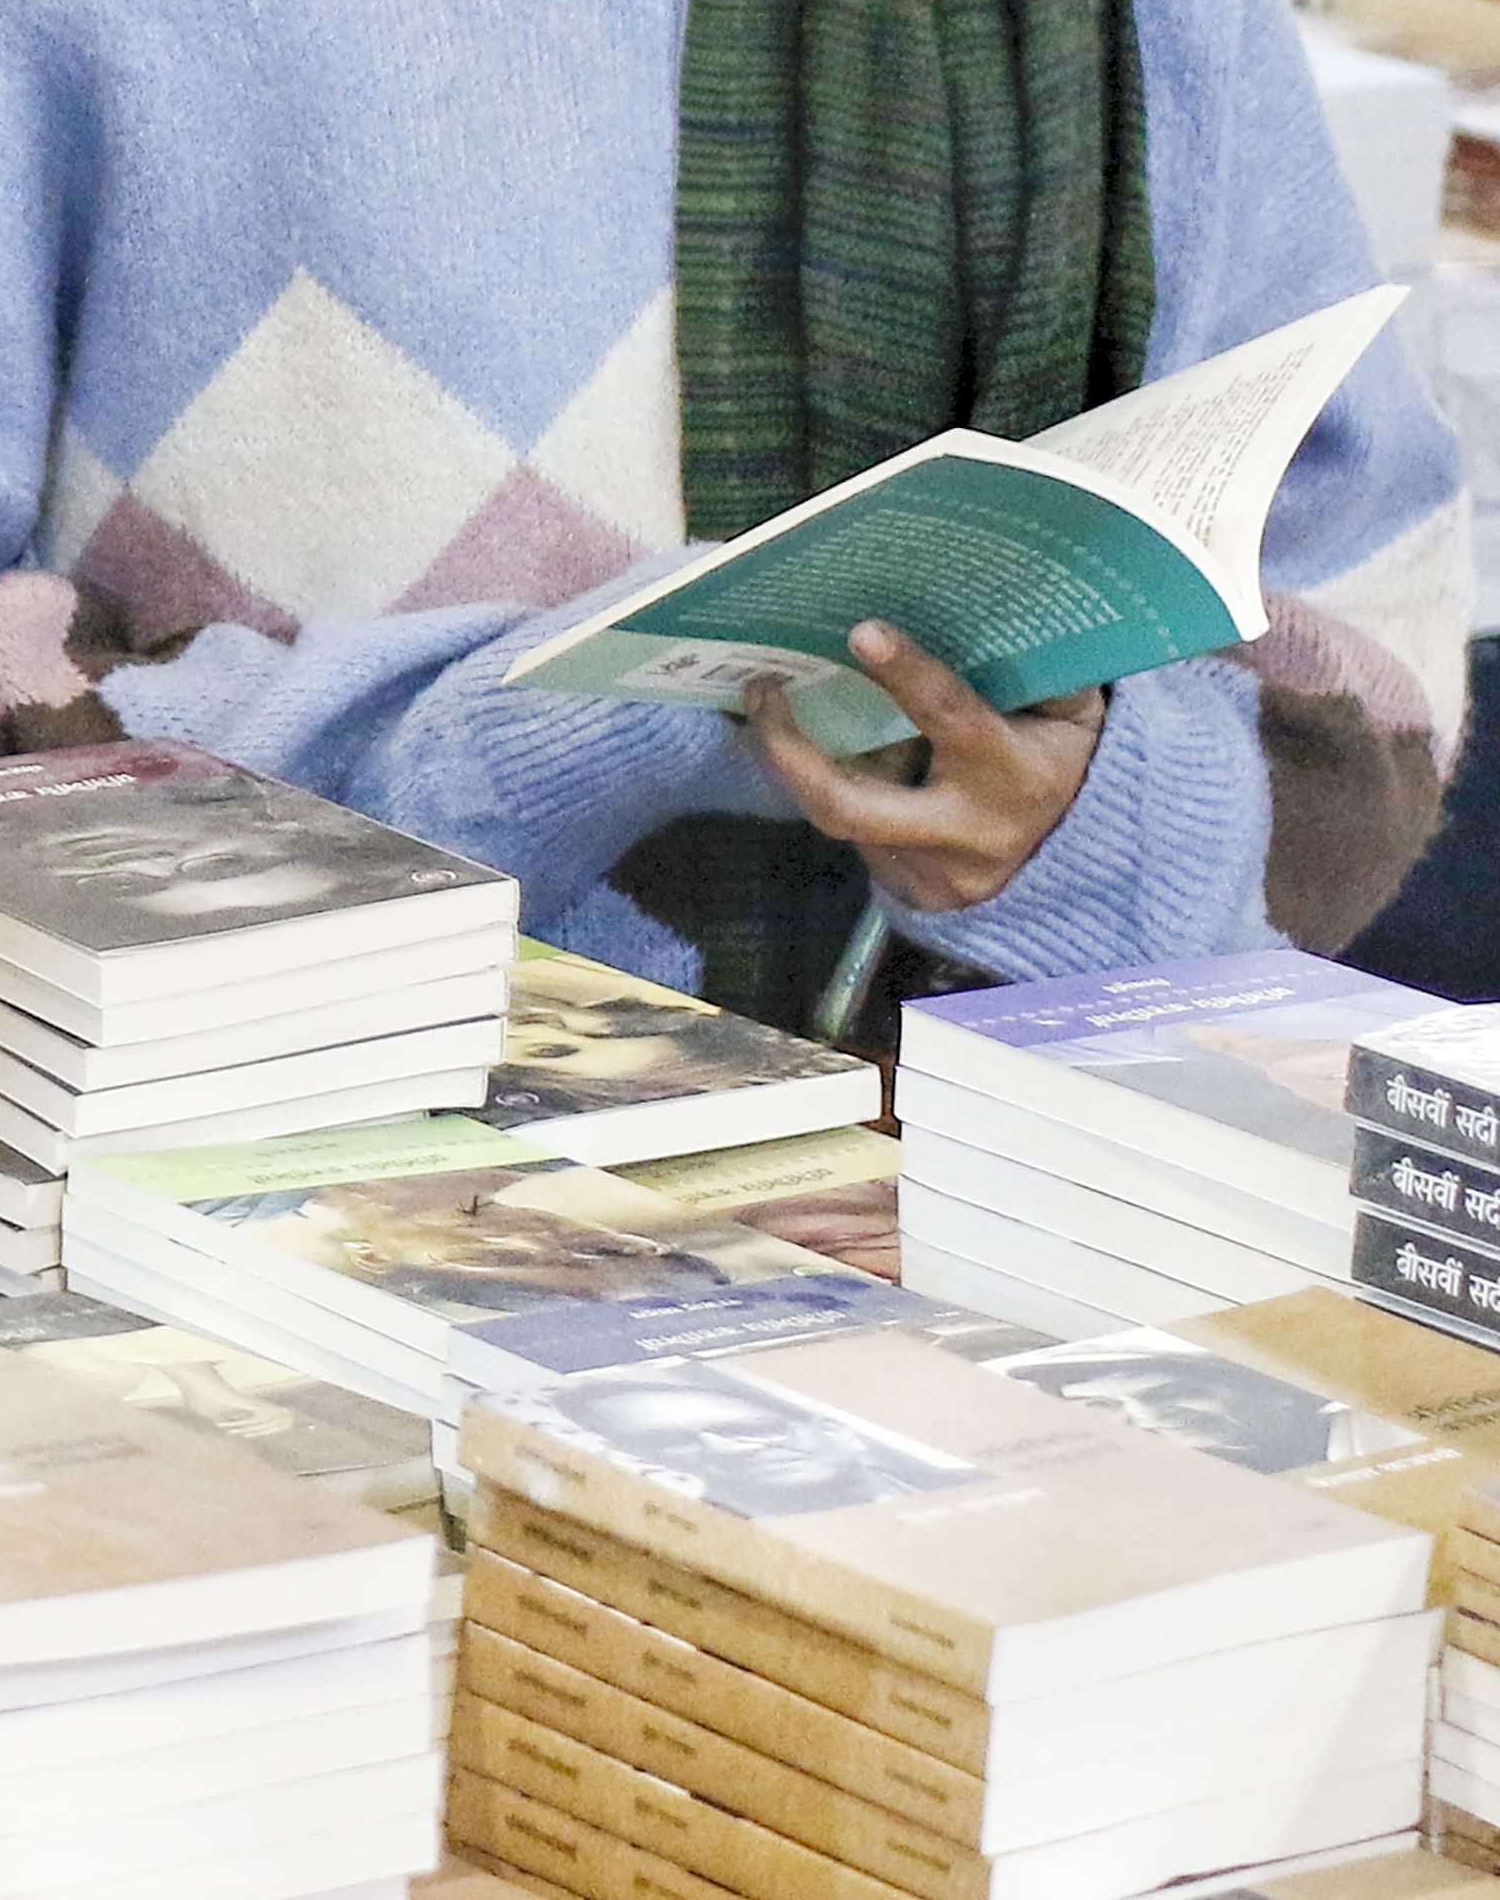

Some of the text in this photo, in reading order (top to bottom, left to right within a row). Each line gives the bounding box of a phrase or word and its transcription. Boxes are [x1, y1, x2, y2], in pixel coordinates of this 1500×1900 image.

[1386, 1074, 1498, 1146] बीसवीं सदी
[1392, 1157, 1461, 1213] बीसवीं
[1396, 1242, 1463, 1299] बीसवीं
